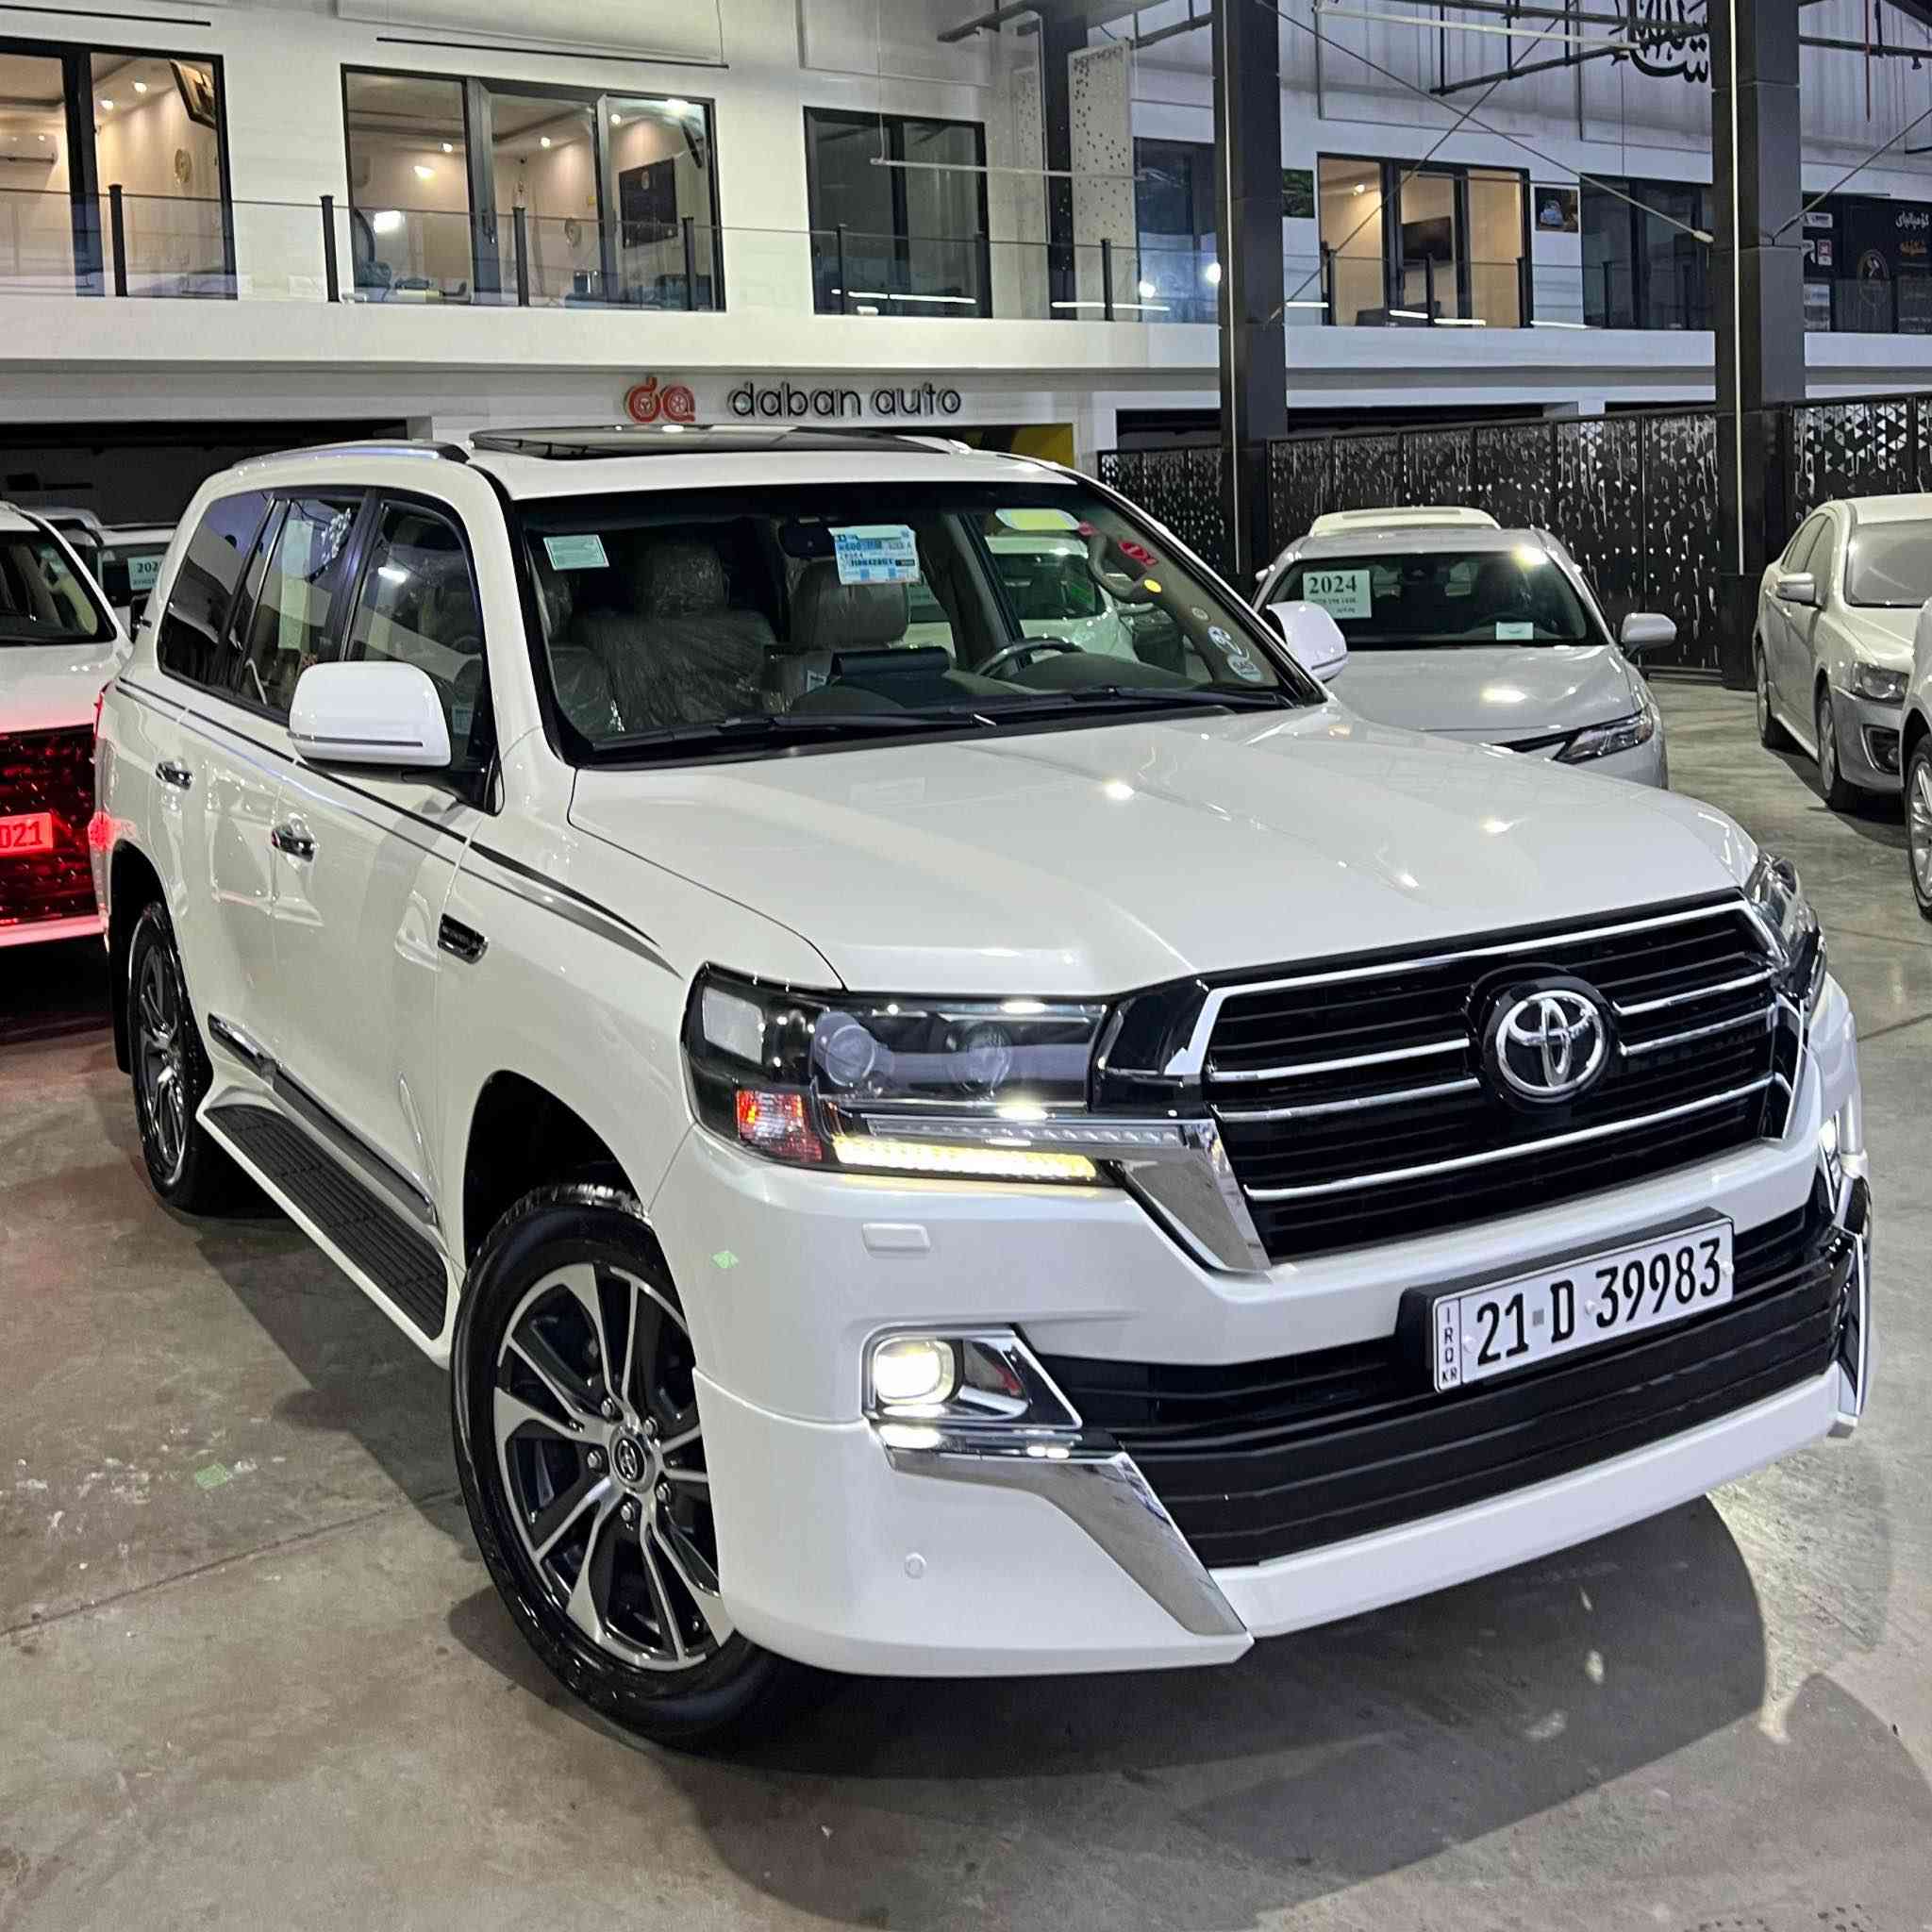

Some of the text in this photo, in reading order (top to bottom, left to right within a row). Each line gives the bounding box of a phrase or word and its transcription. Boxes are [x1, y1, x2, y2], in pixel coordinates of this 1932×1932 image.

[728, 381, 961, 418] daban auto
[1307, 574, 1357, 594] 2024
[1475, 1237, 1722, 1367] 21 D 39983
